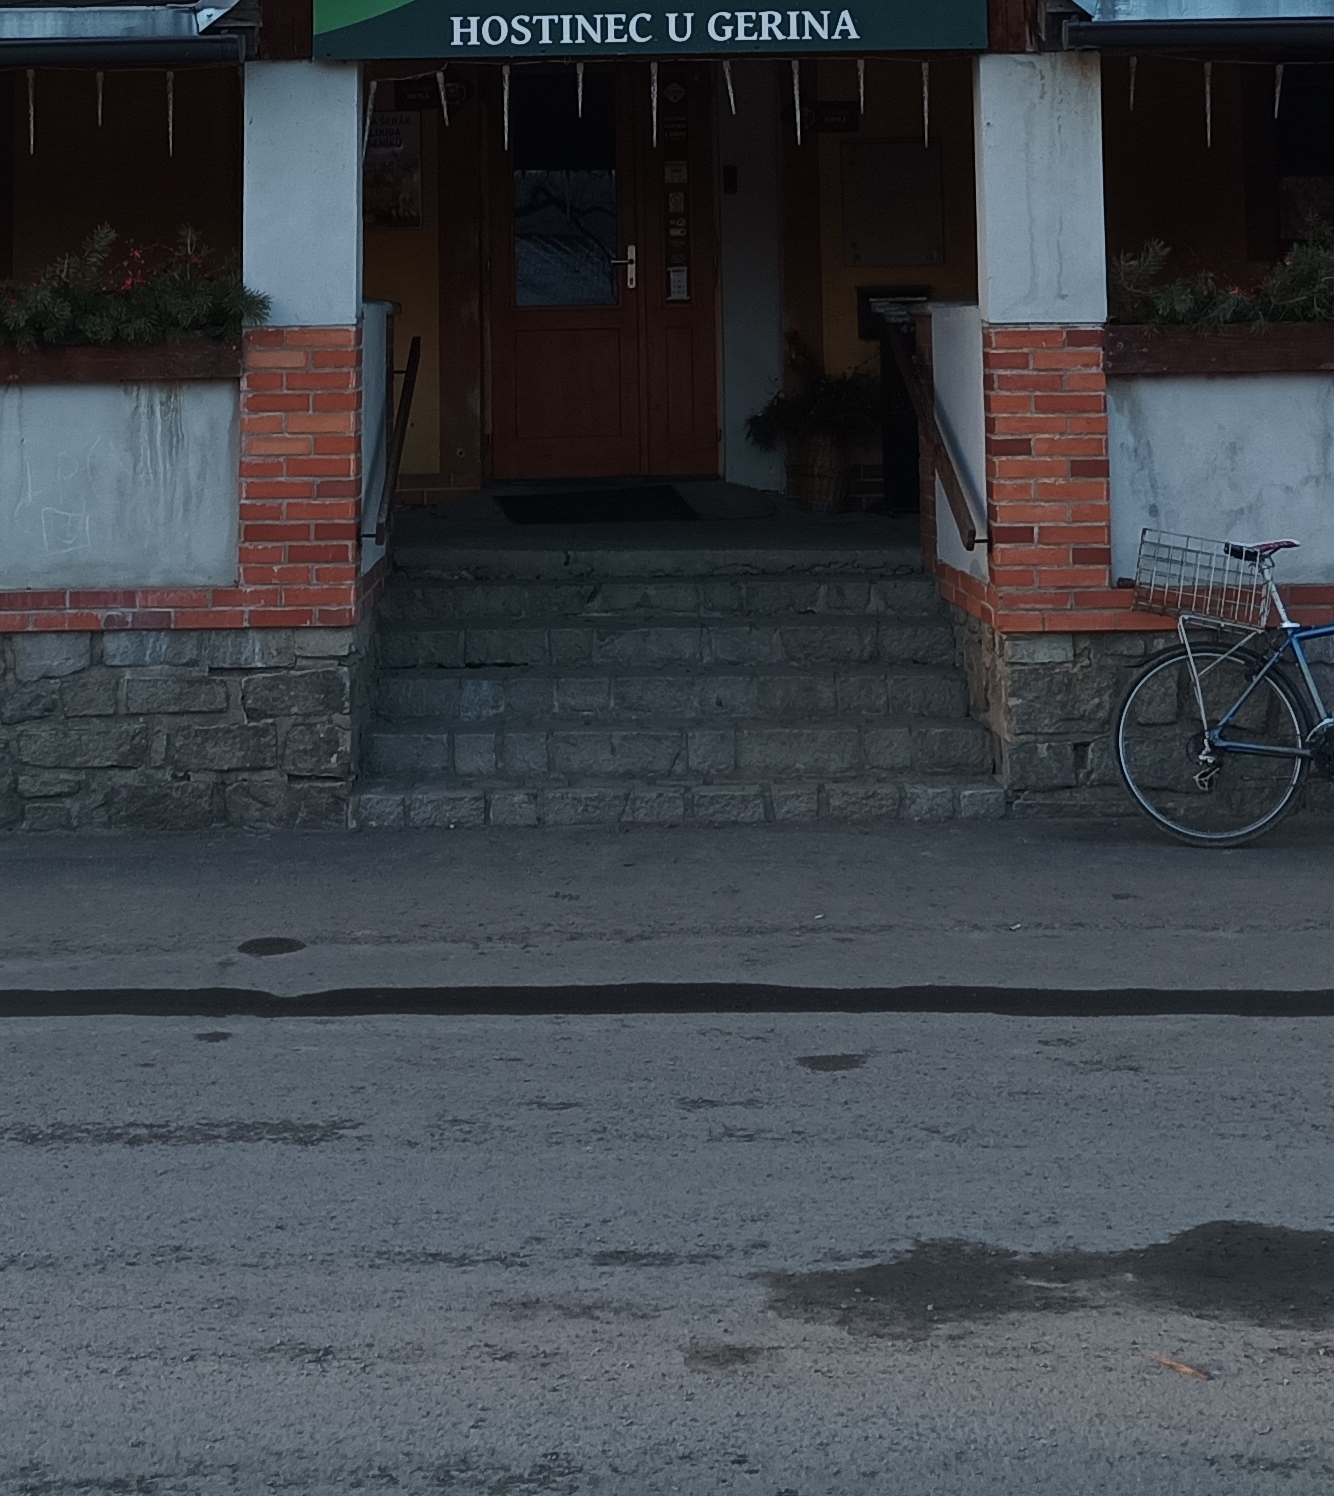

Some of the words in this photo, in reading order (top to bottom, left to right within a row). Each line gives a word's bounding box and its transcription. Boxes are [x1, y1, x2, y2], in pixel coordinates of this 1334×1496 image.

[450, 12, 653, 47] HOSTINEC
[666, 12, 695, 42] U
[707, 9, 860, 42] GERINA
